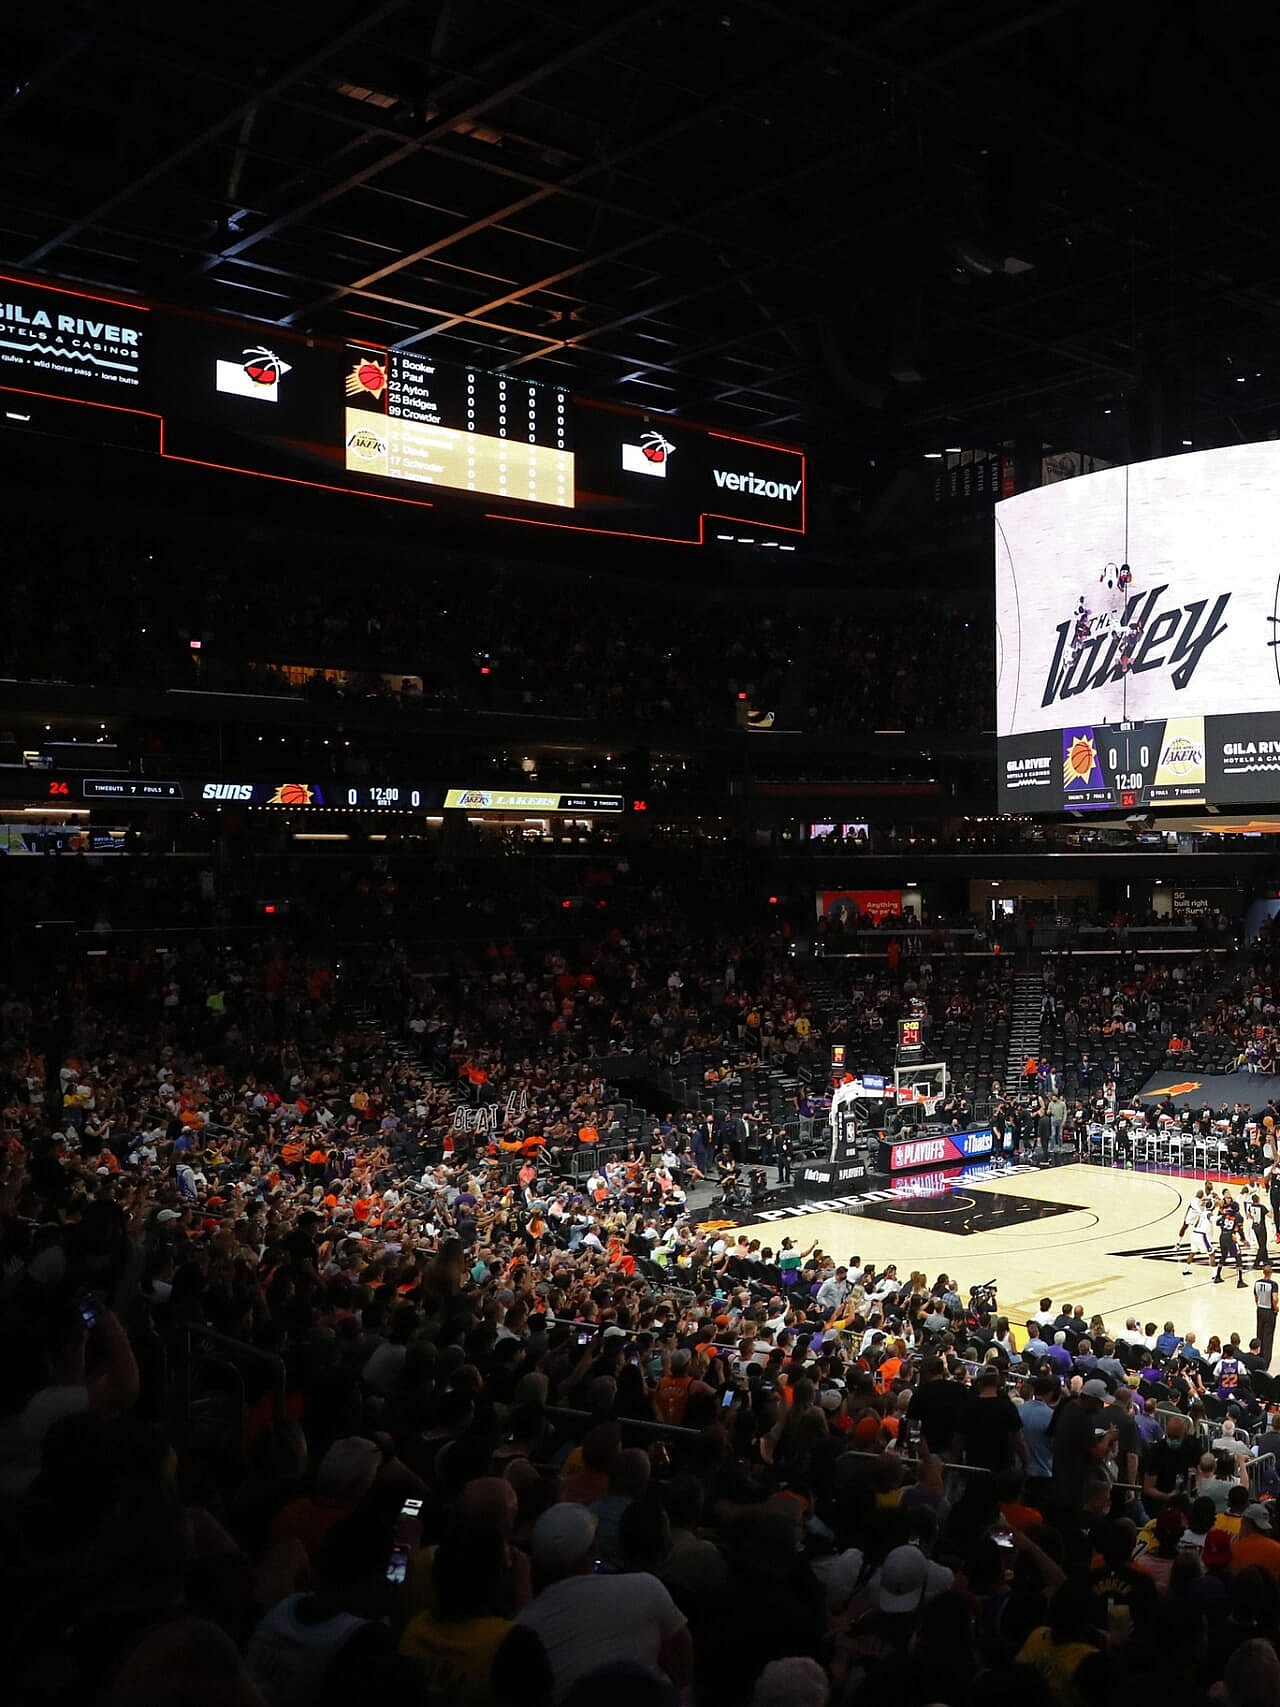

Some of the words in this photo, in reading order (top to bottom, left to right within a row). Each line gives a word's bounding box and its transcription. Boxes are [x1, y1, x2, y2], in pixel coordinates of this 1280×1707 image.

[58, 314, 138, 346] RIVER
[72, 340, 138, 358] CASINOS
[34, 360, 50, 368] wild
[52, 363, 73, 372] horse
[74, 368, 92, 377] pass
[102, 372, 117, 381] lone
[119, 376, 138, 385] butte
[392, 358, 397, 366] 1
[402, 360, 436, 374] Booker
[468, 374, 475, 383] 0
[500, 381, 506, 390] 0
[529, 388, 535, 396] 0
[558, 394, 564, 403] 0
[392, 369, 398, 378] 3
[402, 372, 424, 383] Paul
[468, 385, 475, 395] 0
[500, 392, 506, 401] 0
[529, 398, 535, 407] 0
[558, 405, 564, 414] 0
[388, 381, 401, 391] 22
[402, 384, 429, 397] Ayton
[468, 397, 475, 407] 0
[500, 404, 506, 413] 0
[529, 410, 535, 419] 0
[558, 416, 564, 425] 0
[388, 394, 401, 404] 25
[402, 396, 437, 410] Bridges
[468, 409, 475, 418] 0
[500, 416, 506, 425] 0
[529, 422, 535, 431] 0
[558, 428, 564, 437] 0
[388, 406, 401, 416] 99
[402, 408, 441, 424] Crowder
[468, 421, 475, 431] 0
[500, 428, 506, 437] 0
[529, 434, 535, 443] 0
[558, 440, 564, 448] 0
[713, 468, 792, 502] verizon
[1109, 748, 1117, 769] 0
[1140, 746, 1149, 768] 0
[1160, 745, 1203, 766] LAKERS
[1224, 743, 1257, 755] GILA
[1007, 758, 1024, 772] GILA
[1024, 757, 1050, 770] RIVER
[50, 783, 69, 794] 24
[202, 784, 253, 800] SUNS
[1116, 773, 1143, 790] 12:00
[348, 789, 356, 805] 0
[370, 788, 398, 800] 12:00
[411, 791, 420, 806] 0
[1123, 796, 1133, 804] 24
[634, 801, 646, 810] 24
[903, 1031, 918, 1044] 24
[454, 1104, 498, 1132] BEAT
[507, 1090, 528, 1113] LA
[904, 1140, 944, 1164] PLAYOFFS
[942, 1164, 1040, 1187] SUNS
[1222, 1374, 1238, 1388] 22
